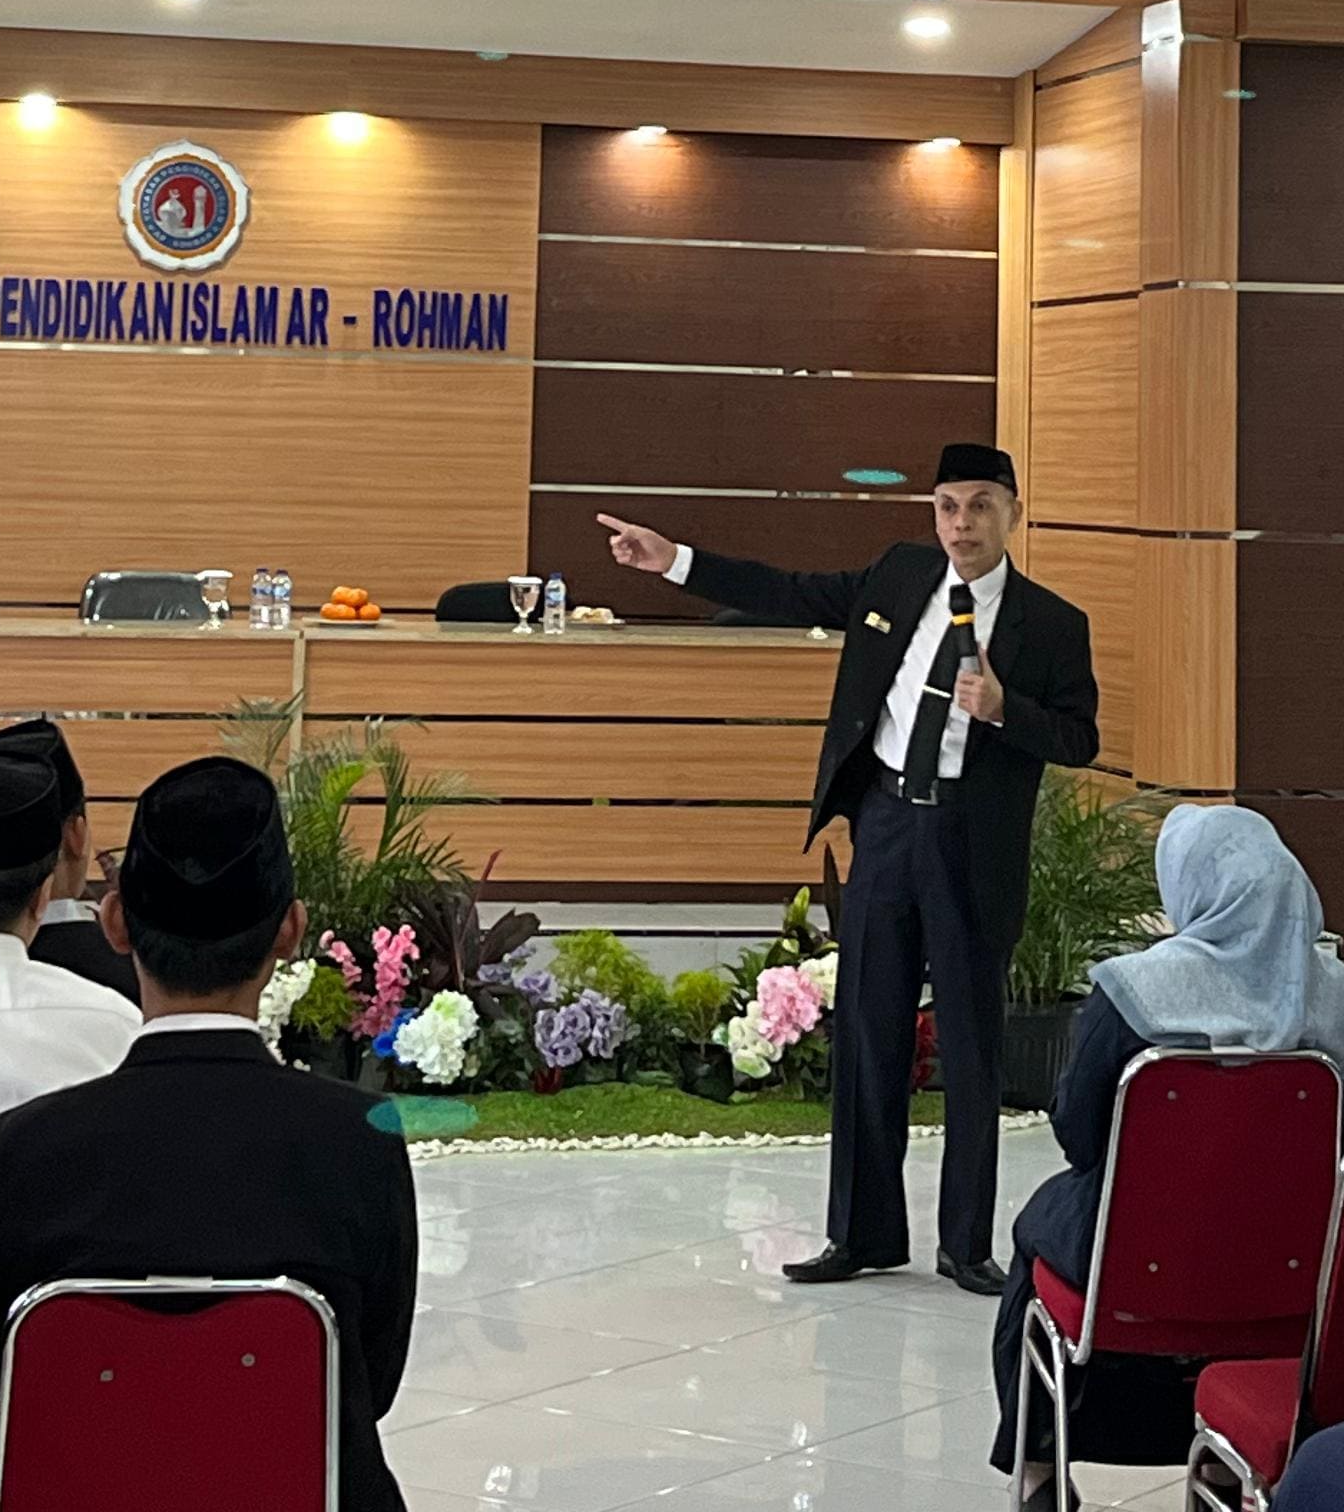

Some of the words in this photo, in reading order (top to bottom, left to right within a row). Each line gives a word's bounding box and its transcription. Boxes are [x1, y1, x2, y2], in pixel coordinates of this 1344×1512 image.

[181, 282, 279, 345] ISLAM
[285, 287, 329, 346] AR
[373, 288, 508, 351] ROHMAN
